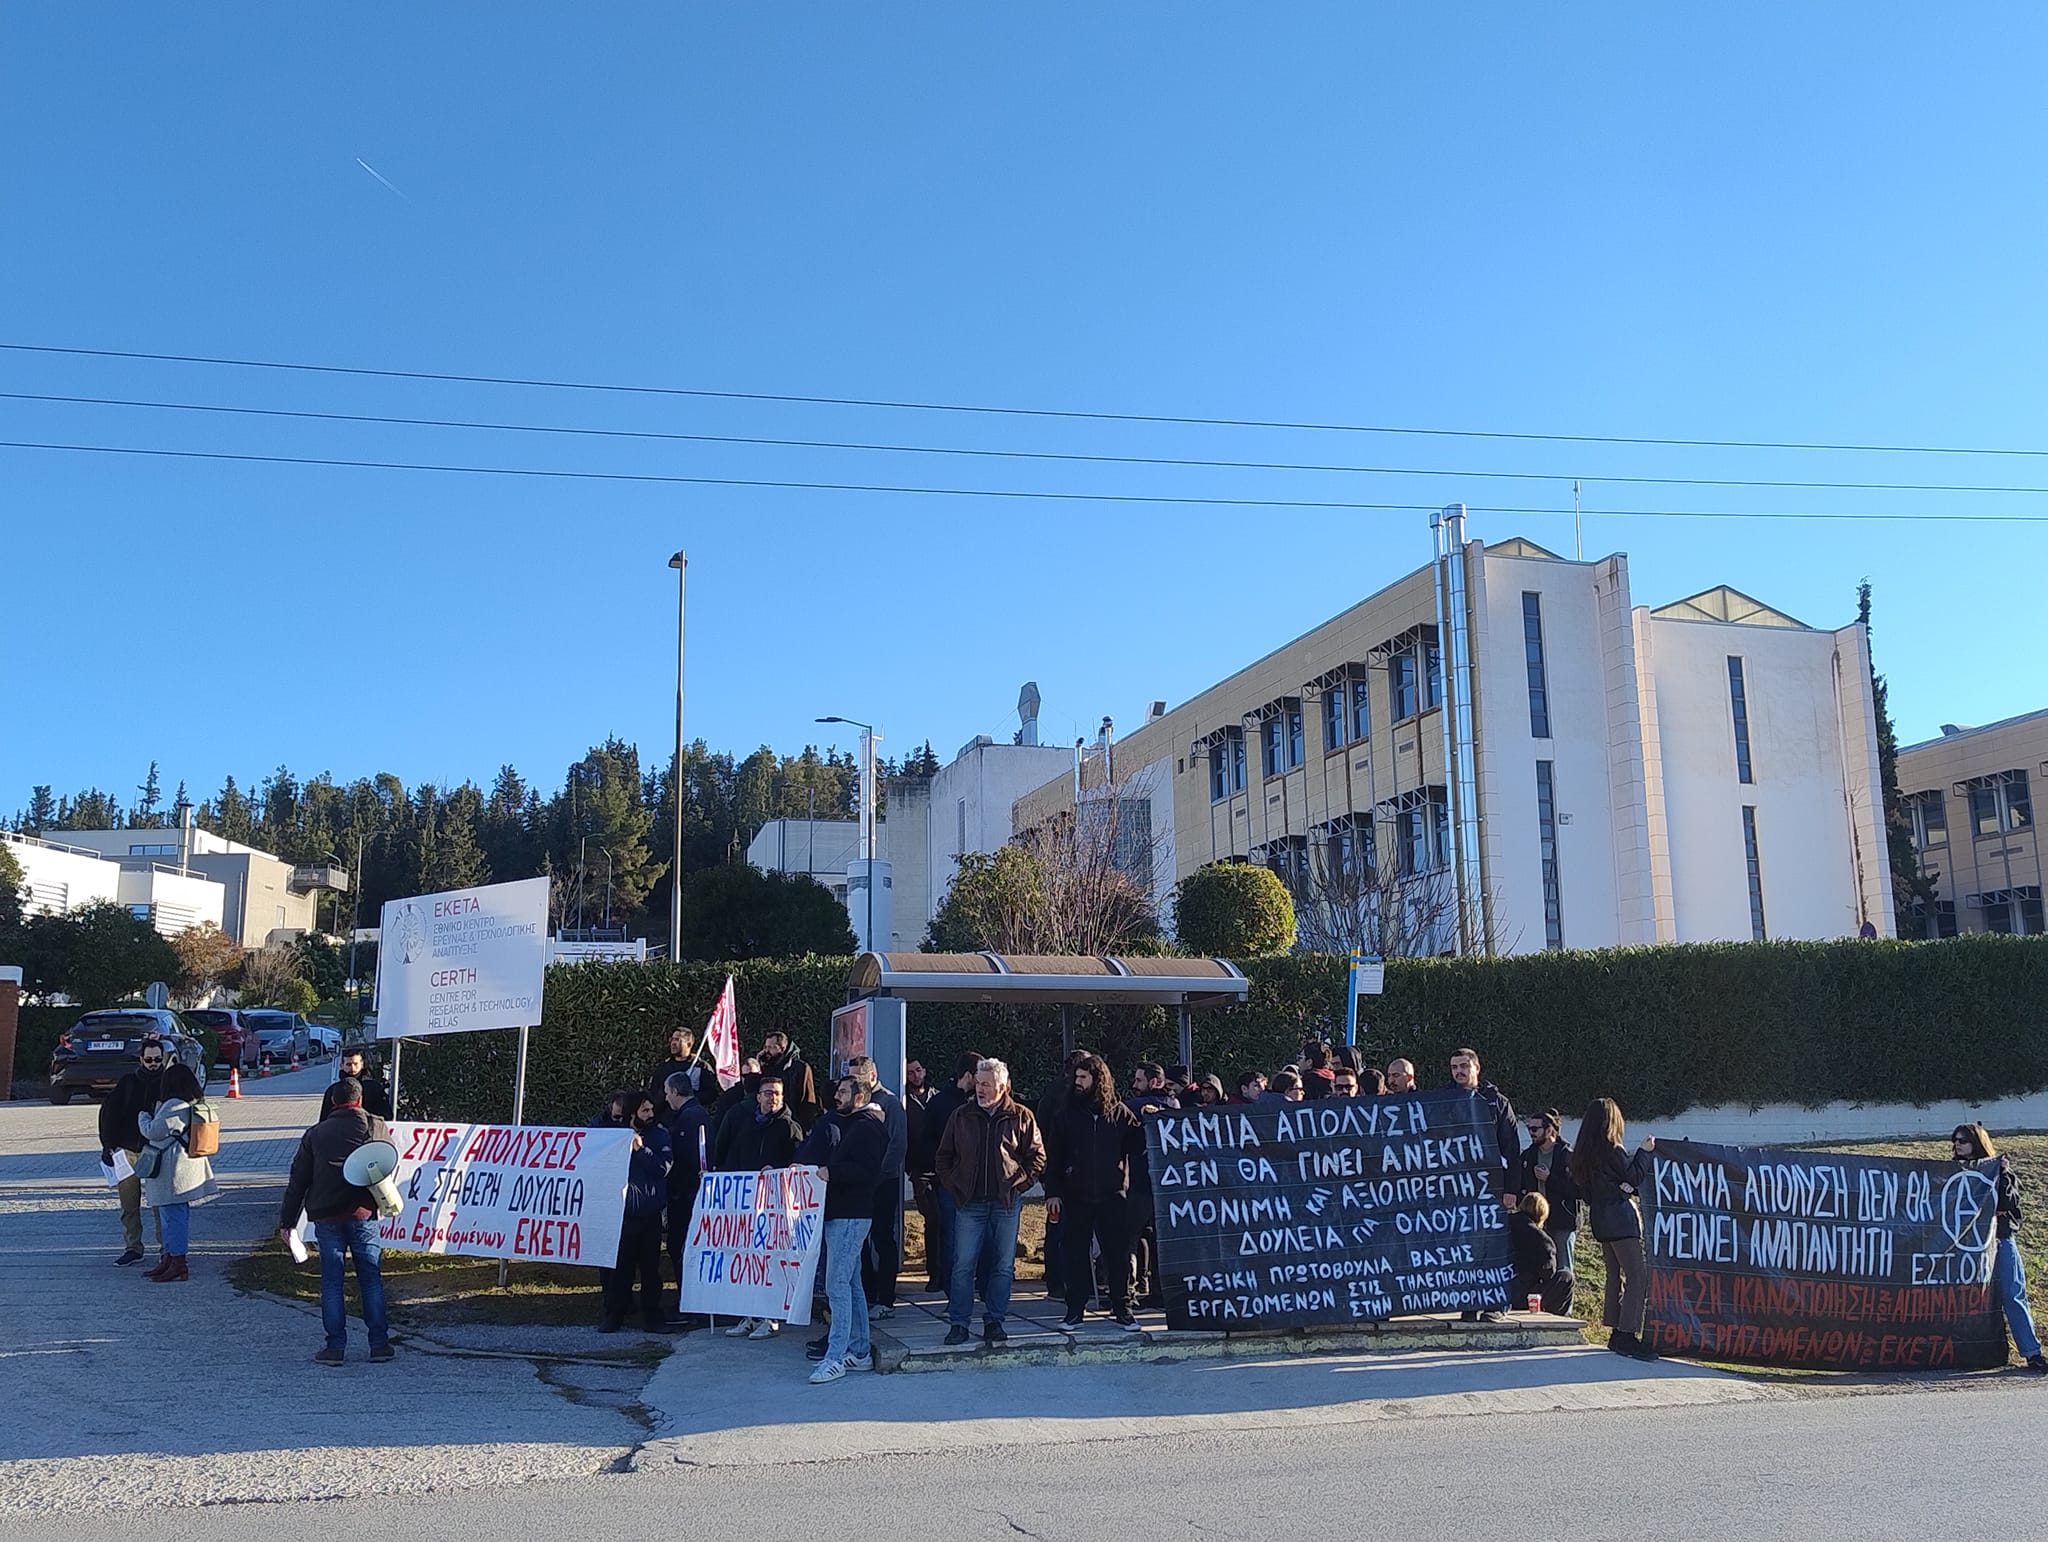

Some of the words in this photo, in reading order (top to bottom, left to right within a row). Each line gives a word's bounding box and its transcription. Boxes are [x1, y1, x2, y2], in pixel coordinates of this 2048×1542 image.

[434, 897, 480, 917] ΕΚΕΤΑ
[433, 920, 462, 934] ΕΘΝΙΚΟ
[463, 916, 495, 931] ΚΕΝΤΡΟ
[433, 932, 468, 946] ΕΡΕΥΝΑΣ
[469, 933, 475, 943] &
[477, 923, 537, 940] ΤΕΧΝΟΛΟΓΙΚΗΣ
[430, 968, 477, 987] CERTH
[429, 1002, 470, 1016] RESEARCH
[471, 1003, 477, 1012] &
[479, 997, 532, 1012] TECHNOLOGY
[430, 991, 460, 1004] CENTRE
[461, 990, 477, 1001] FOR
[428, 1016, 459, 1029] HELLAS
[1157, 1111, 1261, 1155] ΚΑΜΙΑ
[1276, 1100, 1428, 1144] ΑΠΟΛΥΣΗ
[403, 1128, 457, 1161] ΣΤΙΣ
[463, 1128, 586, 1171] ΑΠΟΛΥΣΕΙΣ
[1160, 1158, 1219, 1187] ΔΕΝ
[1238, 1157, 1278, 1184] ΘΑ
[1299, 1148, 1362, 1182] ΓΙΝΕΙ
[1382, 1134, 1484, 1174] ΑΝΕΚΤΗ
[408, 1167, 422, 1200] &
[428, 1167, 504, 1208] ΣΤΑΘΕΡΗ
[508, 1174, 584, 1217] ΔΟΥΛΕΙΑ
[701, 1175, 753, 1210] ΠΑΡΤΕ
[1169, 1195, 1292, 1228] ΜΟΝΙΜΗ
[1305, 1187, 1333, 1217] ΚΑΙ
[1342, 1171, 1496, 1209] ΑΞΙΟΠΡΕΠΗΣ
[1653, 1156, 1731, 1210] ΚΑΜΙΑ
[1744, 1163, 1848, 1219] ΑΠΟΛΥΣΗ
[1858, 1168, 1899, 1222] ΔΕΝ
[1906, 1170, 1934, 1222] ΘΑ
[411, 1206, 506, 1250] Εργαζομένων
[514, 1218, 581, 1260] ΕΚΕΤΑ
[754, 1212, 768, 1249] &
[1239, 1225, 1344, 1255] ΔΟΥΛΕΙΑ
[1352, 1217, 1380, 1243] ΓΙΑ
[1653, 1211, 1738, 1263] ΜΕΙΝΕΙ
[1750, 1219, 1892, 1277] ΑΝΑΠΑΝΤΗΤΗ
[699, 1250, 724, 1283] ΓΙΑ
[1183, 1269, 1258, 1292] ΤΑΞΙΚΗ
[1410, 1244, 1475, 1268] ΒΑΣΗΣ
[1187, 1288, 1335, 1319] ΕΡΓΑΖΟΜΕΝΩΝ
[1348, 1279, 1384, 1298] ΣΤΙΣ
[1349, 1297, 1392, 1317] ΣΤΗΝ
[1402, 1286, 1507, 1311] ΠΛΗΡΟΦΟΡΙΚΗ
[1650, 1268, 1721, 1314] ΑΜΕΣΗ
[1733, 1276, 1875, 1322] ΙΚΑΝΟΠΟΙΗΣΗ
[1878, 1334, 1955, 1367] ΕΚΕΤΑ
